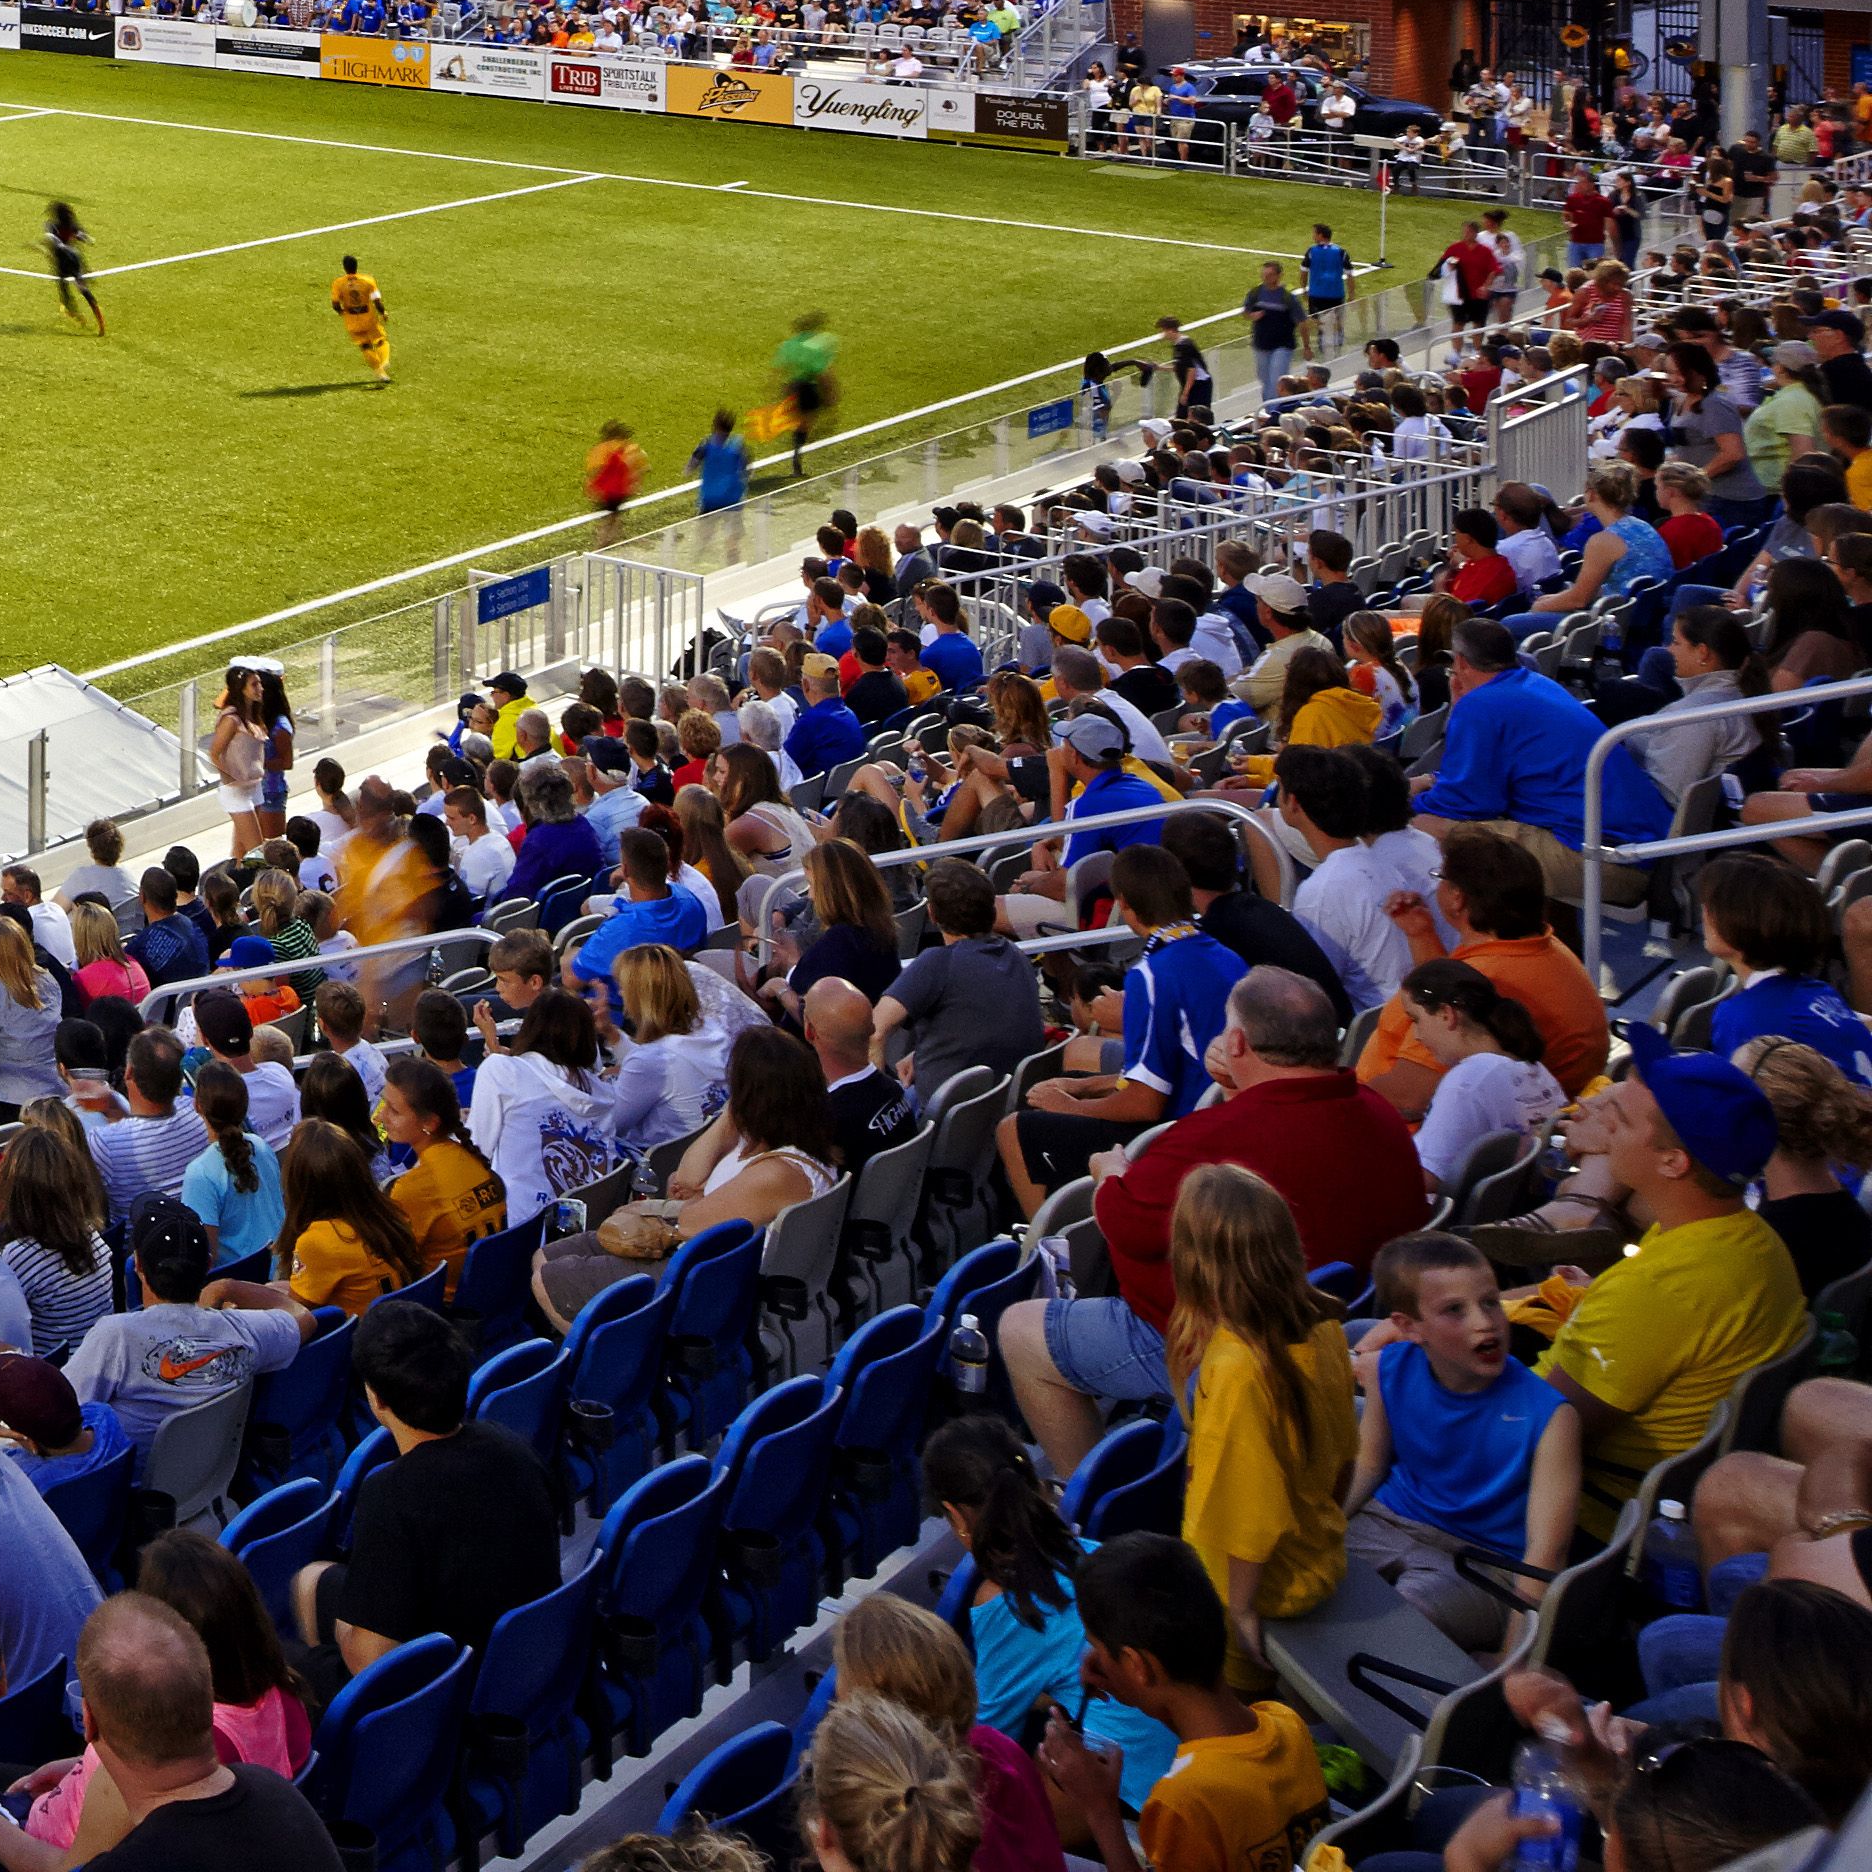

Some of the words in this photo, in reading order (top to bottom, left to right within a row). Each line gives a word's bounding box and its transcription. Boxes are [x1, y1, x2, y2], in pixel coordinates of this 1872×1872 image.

[21, 23, 87, 40] NIKESOCCER.COM
[334, 58, 425, 85] HIGHMARK
[554, 65, 598, 87] TRIB
[603, 79, 657, 91] TRIBLIVE.COM
[796, 84, 925, 128] Yuengling
[996, 110, 1043, 122] DOUBLE
[996, 119, 1018, 129] THE
[1020, 120, 1046, 131] FUN.
